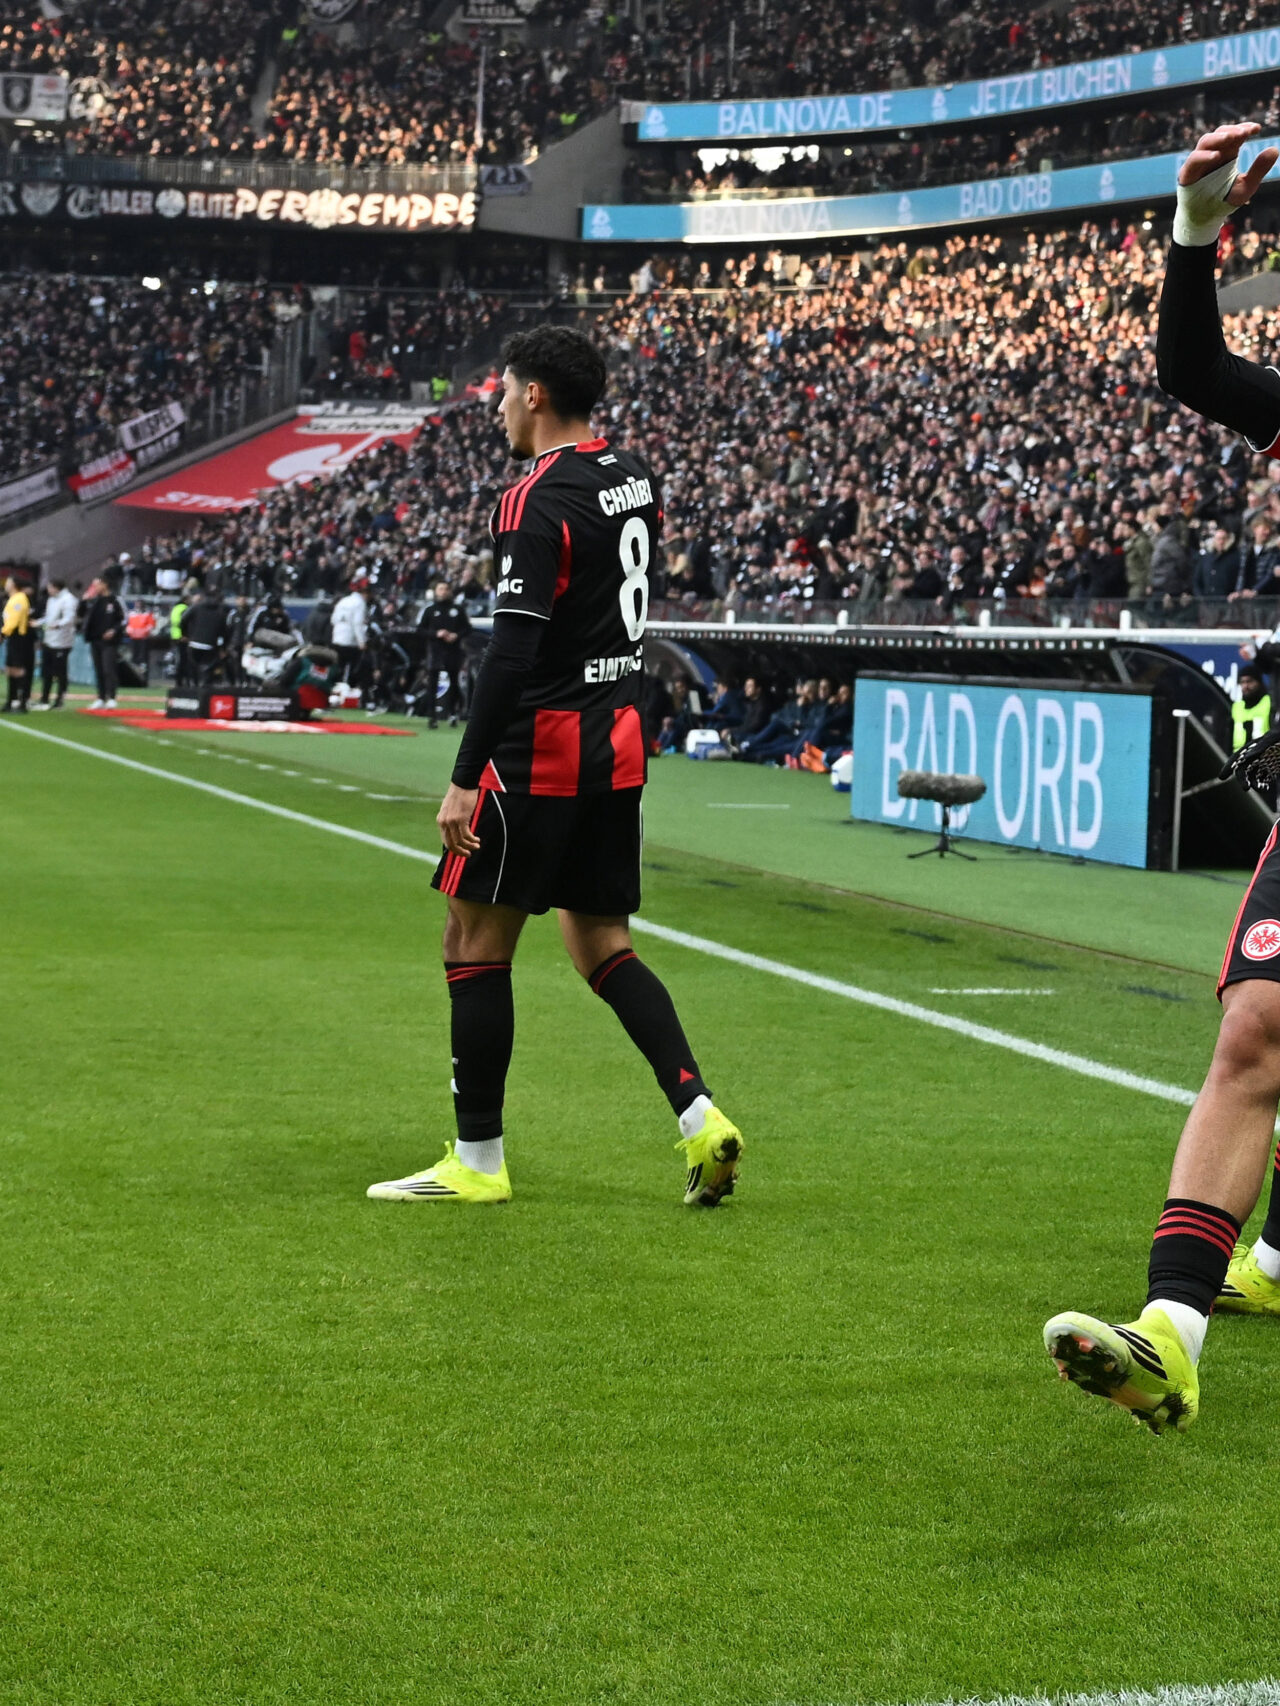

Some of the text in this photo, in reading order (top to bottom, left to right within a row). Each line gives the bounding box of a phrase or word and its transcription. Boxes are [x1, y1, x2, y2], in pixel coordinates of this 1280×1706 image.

[970, 57, 1132, 116] JETZT BUCHEN
[718, 94, 893, 136] BALNOVA.DE
[99, 189, 154, 215] ADLER
[187, 191, 236, 219] ELITE
[235, 188, 476, 228] PER SEMPRE
[959, 174, 1052, 219] BAD ORB
[699, 202, 832, 235] BALNOVA
[598, 476, 654, 517] CHAÏBI
[619, 516, 650, 642] 8
[881, 688, 1105, 851] BAD ORB
